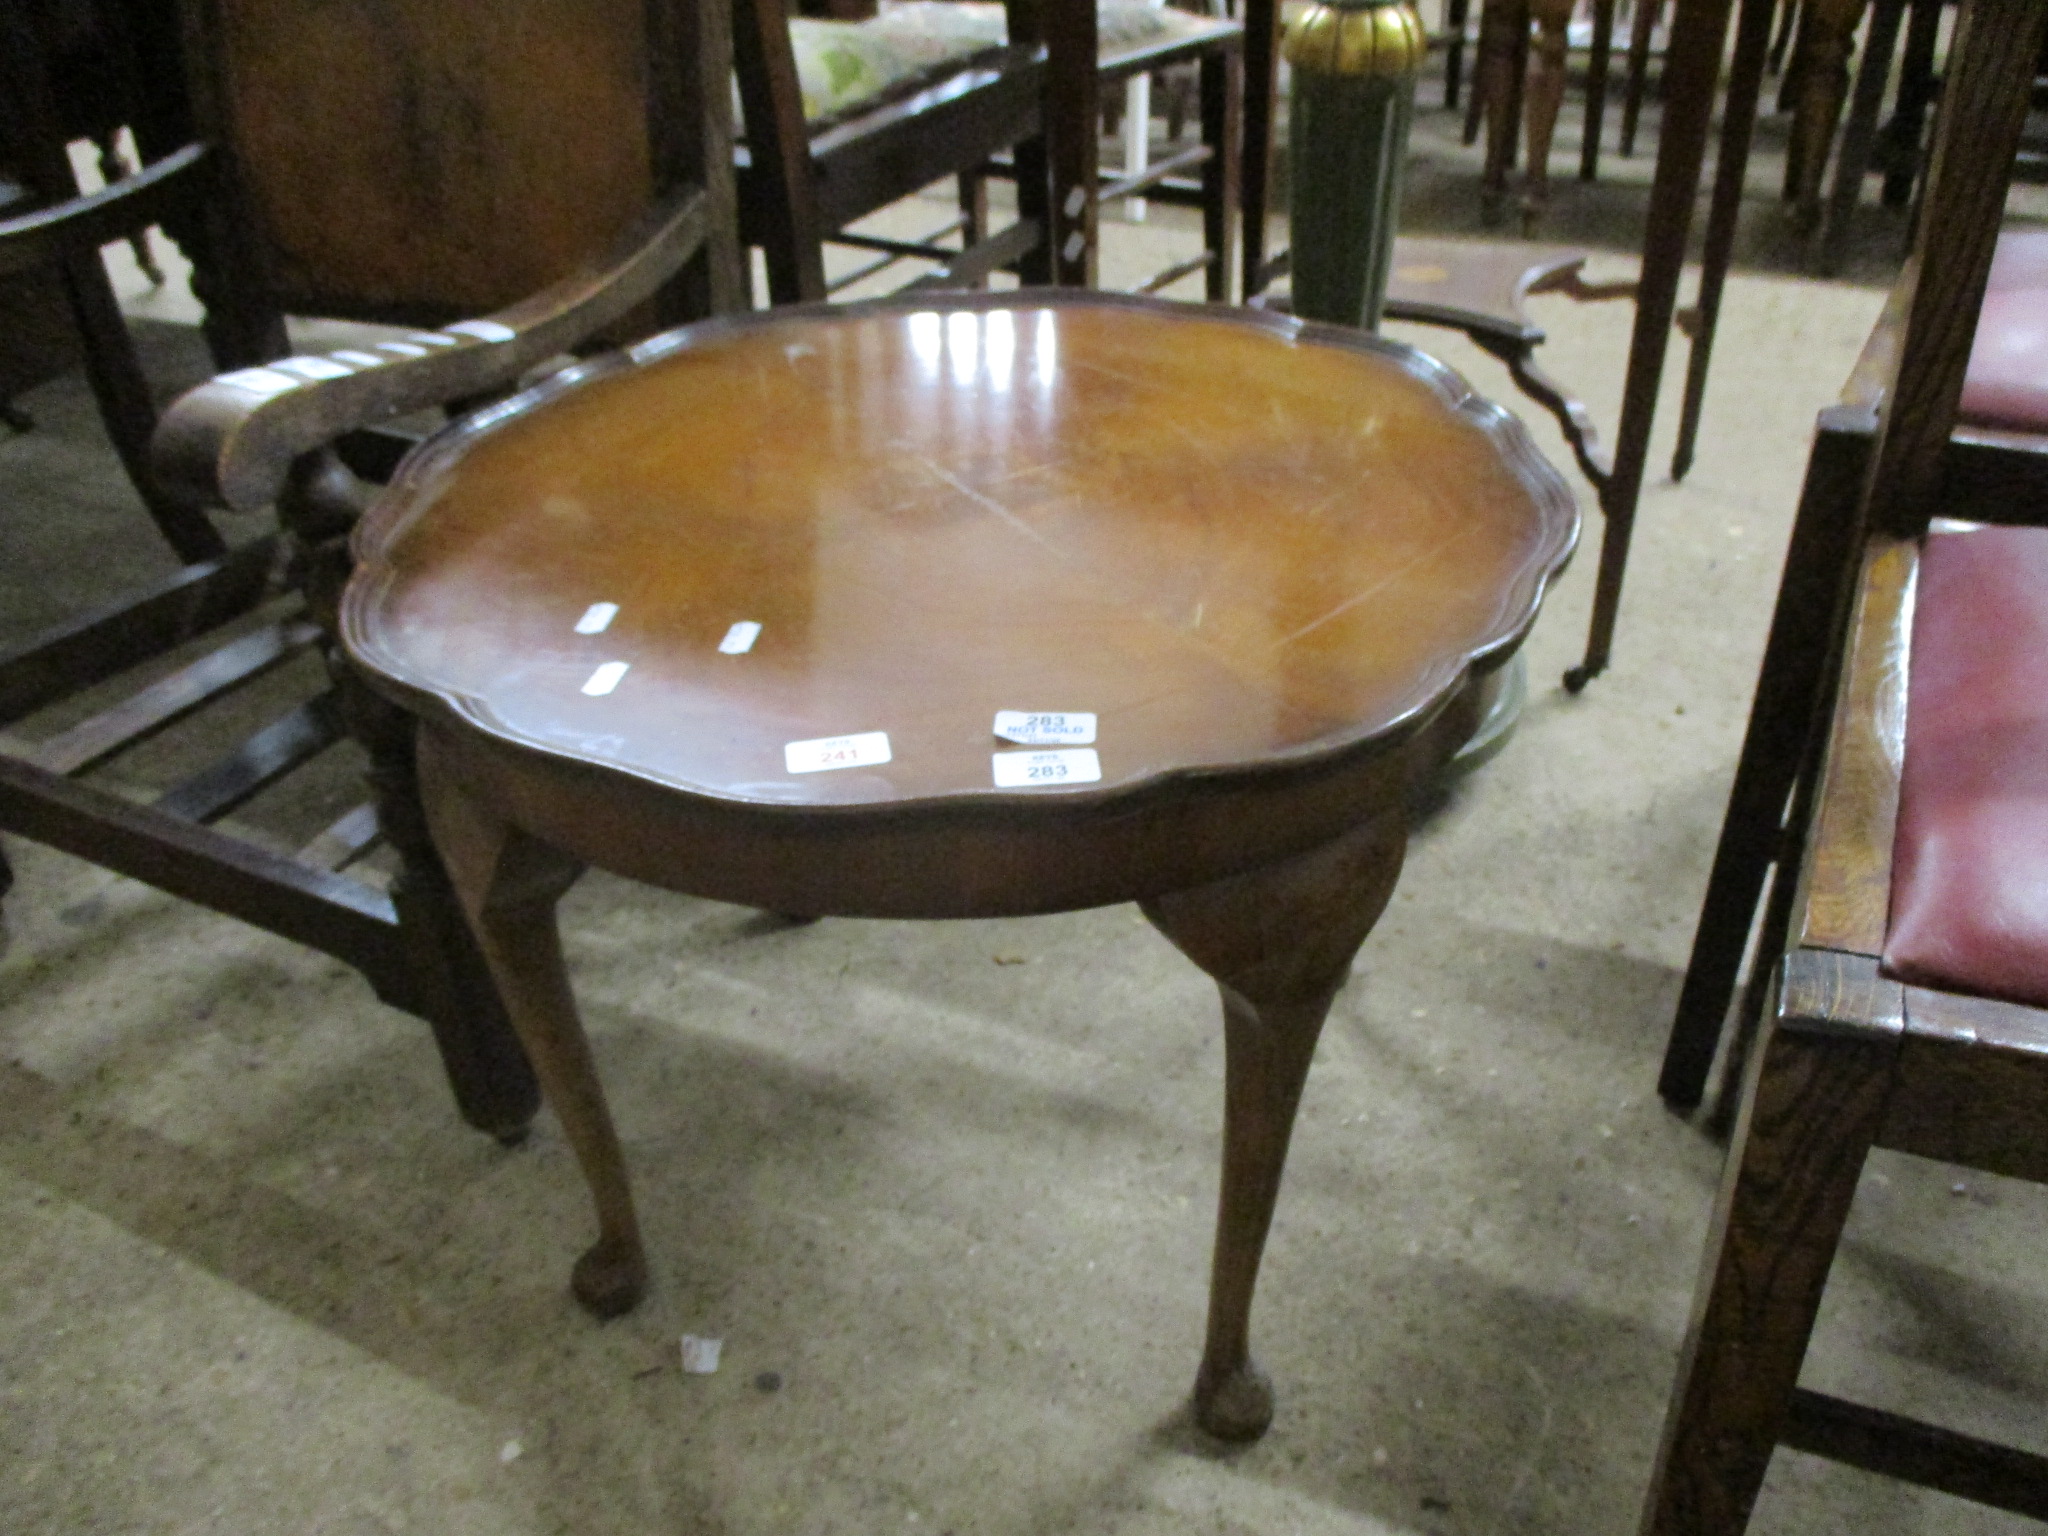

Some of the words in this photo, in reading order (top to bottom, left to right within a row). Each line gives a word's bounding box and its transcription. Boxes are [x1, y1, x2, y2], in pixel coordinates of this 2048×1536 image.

[1027, 714, 1065, 725] 283
[1007, 725, 1036, 734] NOT
[1043, 725, 1083, 734] SOLD
[820, 749, 858, 763] 241
[1028, 765, 1068, 778] 283
